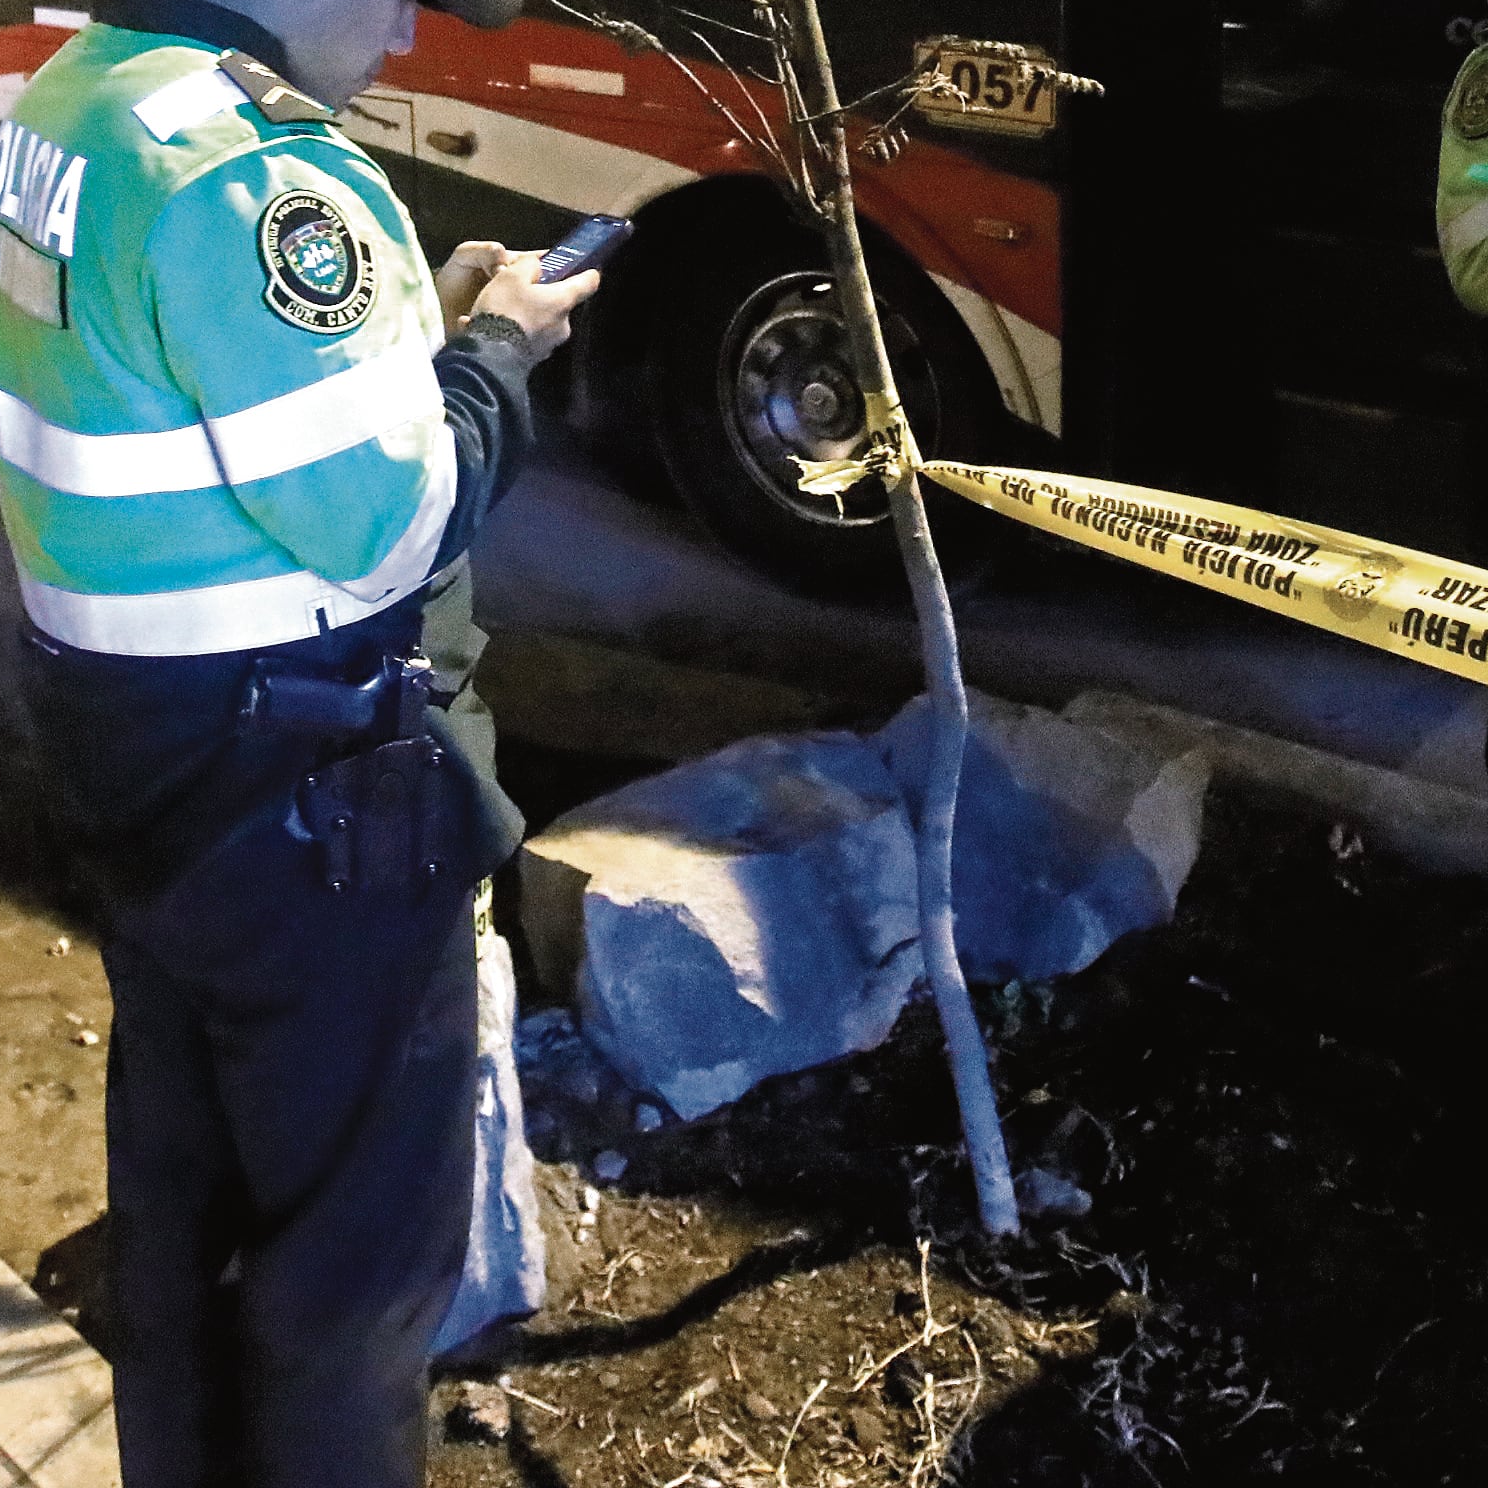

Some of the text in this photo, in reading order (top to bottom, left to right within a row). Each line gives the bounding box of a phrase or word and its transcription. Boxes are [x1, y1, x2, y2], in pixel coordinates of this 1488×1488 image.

[285, 300, 321, 326] COM.
[326, 292, 370, 327] CANTO
[1051, 497, 1173, 554] NACIONAL
